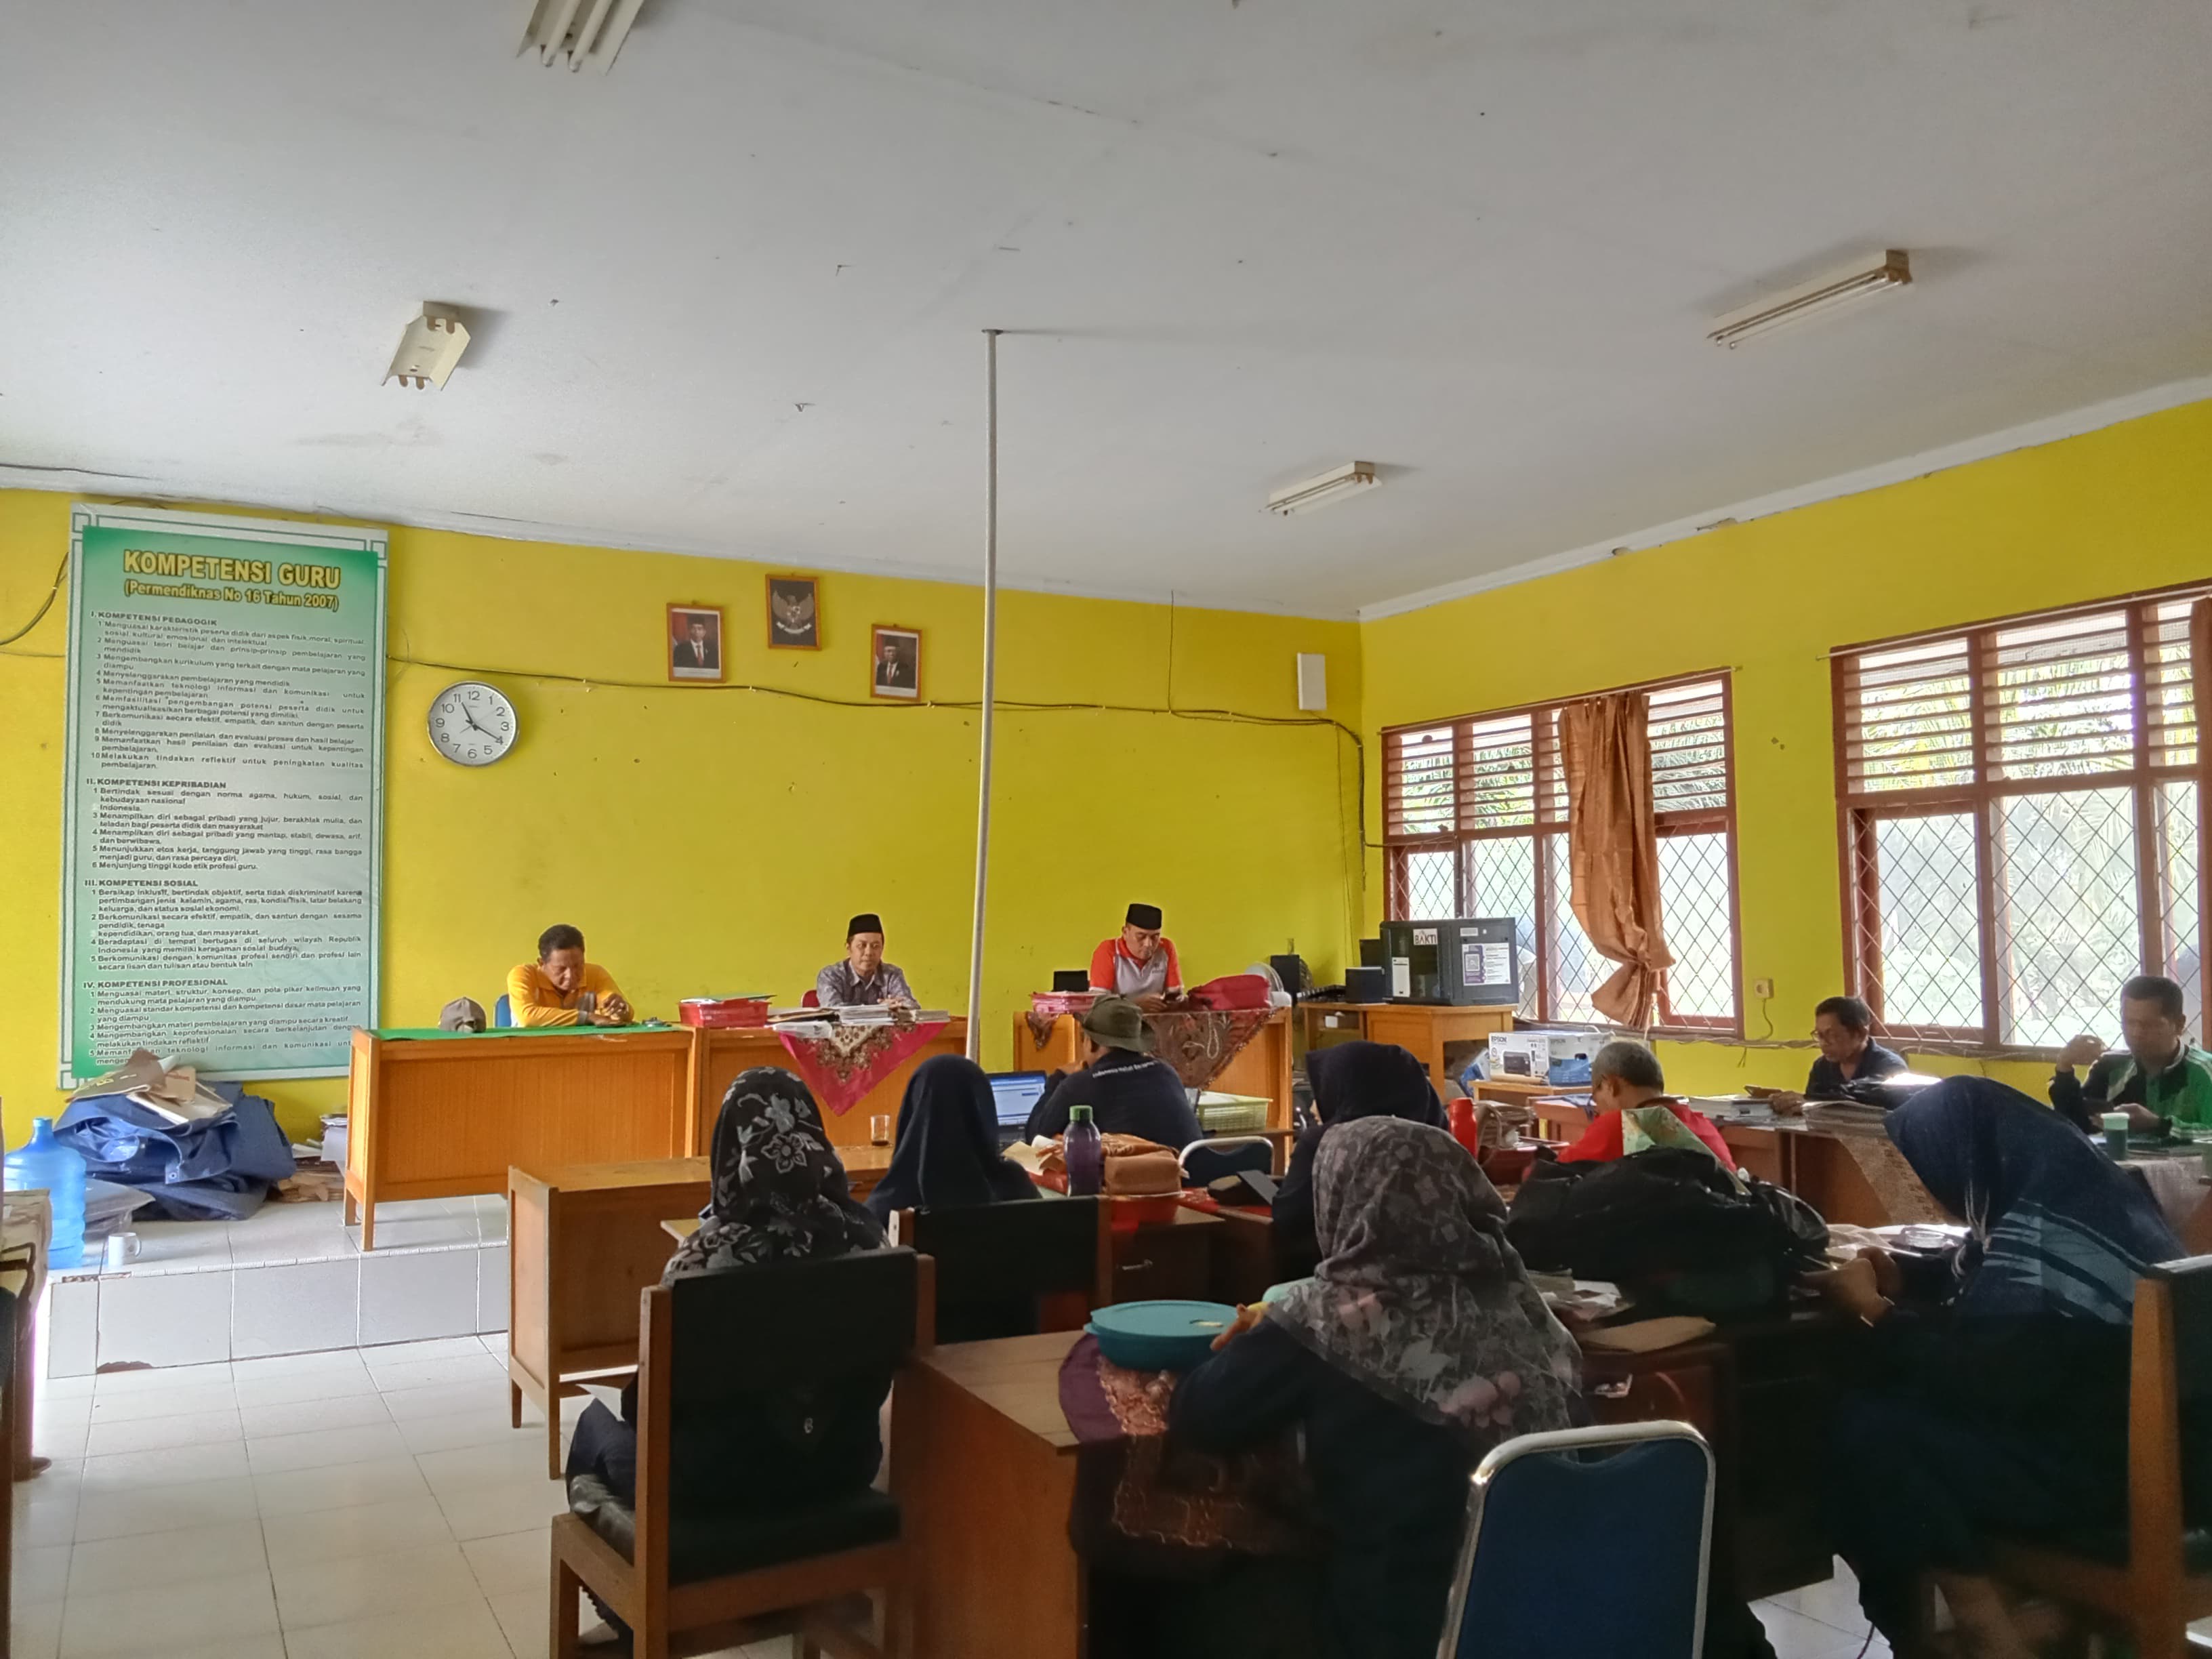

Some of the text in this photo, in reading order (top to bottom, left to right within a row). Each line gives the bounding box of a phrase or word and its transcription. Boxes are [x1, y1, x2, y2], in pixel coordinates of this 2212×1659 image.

[123, 550, 341, 589] KOMPETENSI GURU
[124, 579, 340, 612] (Permendiknas No 16 Tahun 2007)
[98, 611, 160, 621] KOMPETENSI
[162, 615, 217, 625] PEDAGOGIK
[104, 637, 148, 647] Menguasai
[178, 642, 204, 651] belajar
[292, 651, 342, 660] pembelajaran
[103, 662, 134, 670] diampu
[104, 654, 172, 665] Mengembangkan
[262, 663, 290, 672] dengan
[312, 667, 346, 675] pelajaran
[103, 670, 179, 681] Menyelenggarakan
[180, 675, 233, 684] pembelajaran
[103, 678, 164, 687] Memanfaatkan
[171, 682, 210, 691] teknologi
[102, 687, 207, 699] kepentingan pembelajaran
[453, 693, 461, 703] 11
[468, 691, 480, 700] 12
[168, 698, 233, 708] pengembangan
[240, 702, 272, 710] potensi
[279, 704, 309, 712] peserta
[489, 696, 493, 705] 1
[441, 703, 454, 713] 10
[496, 707, 505, 716] 2
[435, 718, 445, 727] 9
[501, 722, 510, 731] 3
[441, 733, 449, 743] 8
[453, 743, 461, 753] 7
[484, 745, 492, 754] 5
[468, 749, 477, 758] 6
[273, 759, 324, 767] peningkatan
[100, 796, 149, 804] kebudayaan
[1415, 935, 1436, 944] BAKTI
[97, 1006, 141, 1015] Menguasai
[175, 1004, 220, 1012] kompetensi
[239, 1002, 283, 1010] kompetensi
[97, 1022, 166, 1031] Mengembangkan
[194, 1019, 247, 1028] pembelajaran
